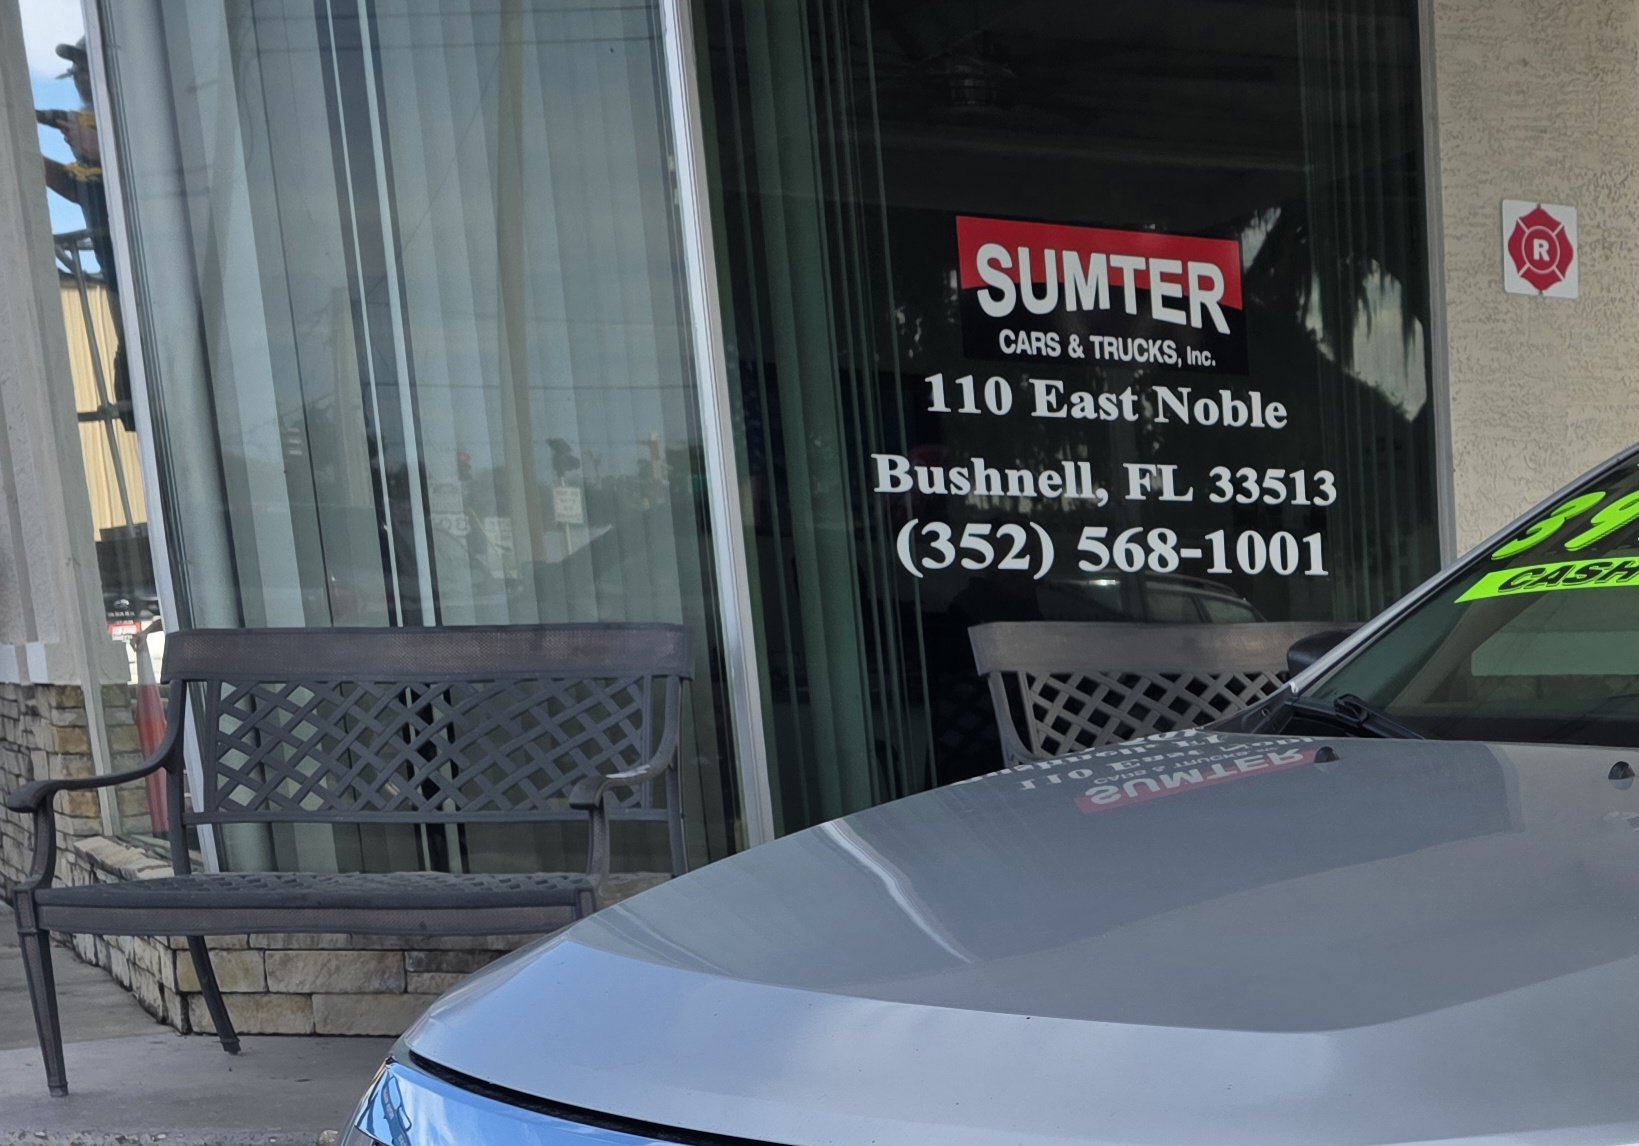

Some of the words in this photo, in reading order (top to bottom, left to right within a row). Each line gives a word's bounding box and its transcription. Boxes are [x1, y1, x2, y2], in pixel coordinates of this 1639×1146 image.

[1533, 238, 1551, 262] R
[976, 243, 1231, 335] SUMTER
[999, 328, 1062, 356] CARS
[1067, 333, 1085, 359] &
[1089, 335, 1182, 368] TRUCKS,
[1186, 346, 1216, 367] Inc.
[924, 374, 1013, 416] 110
[1029, 378, 1139, 422] East
[1153, 386, 1288, 429] Noble
[871, 453, 1109, 507] Bushnell,
[1123, 463, 1194, 502] FL
[1209, 465, 1337, 506] 33513
[896, 519, 1055, 580] (352)
[1076, 526, 1330, 576] 568-1001
